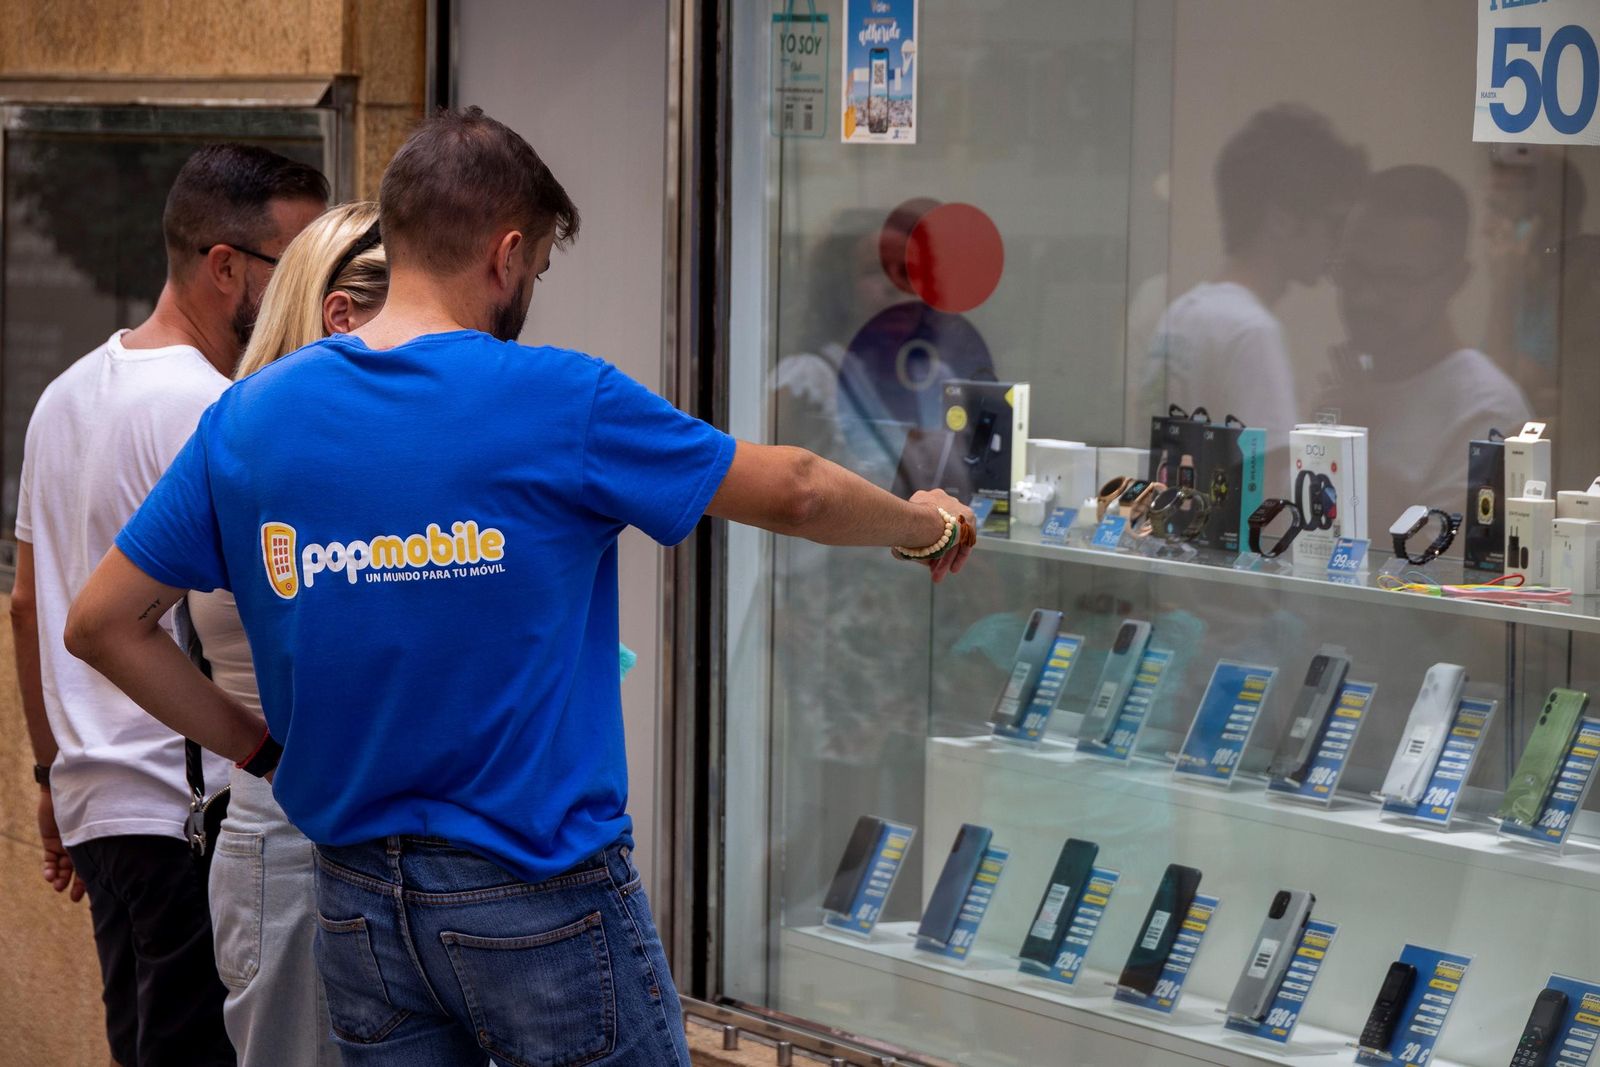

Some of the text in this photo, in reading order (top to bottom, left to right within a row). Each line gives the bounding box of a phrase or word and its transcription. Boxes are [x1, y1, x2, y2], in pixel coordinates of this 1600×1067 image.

[780, 33, 822, 55] YO SOY
[1489, 25, 1599, 134] 50
[1305, 444, 1326, 457] DCU
[302, 520, 505, 588] popmobile
[366, 564, 506, 583] UN MUNDO PARA TU MÓVIL
